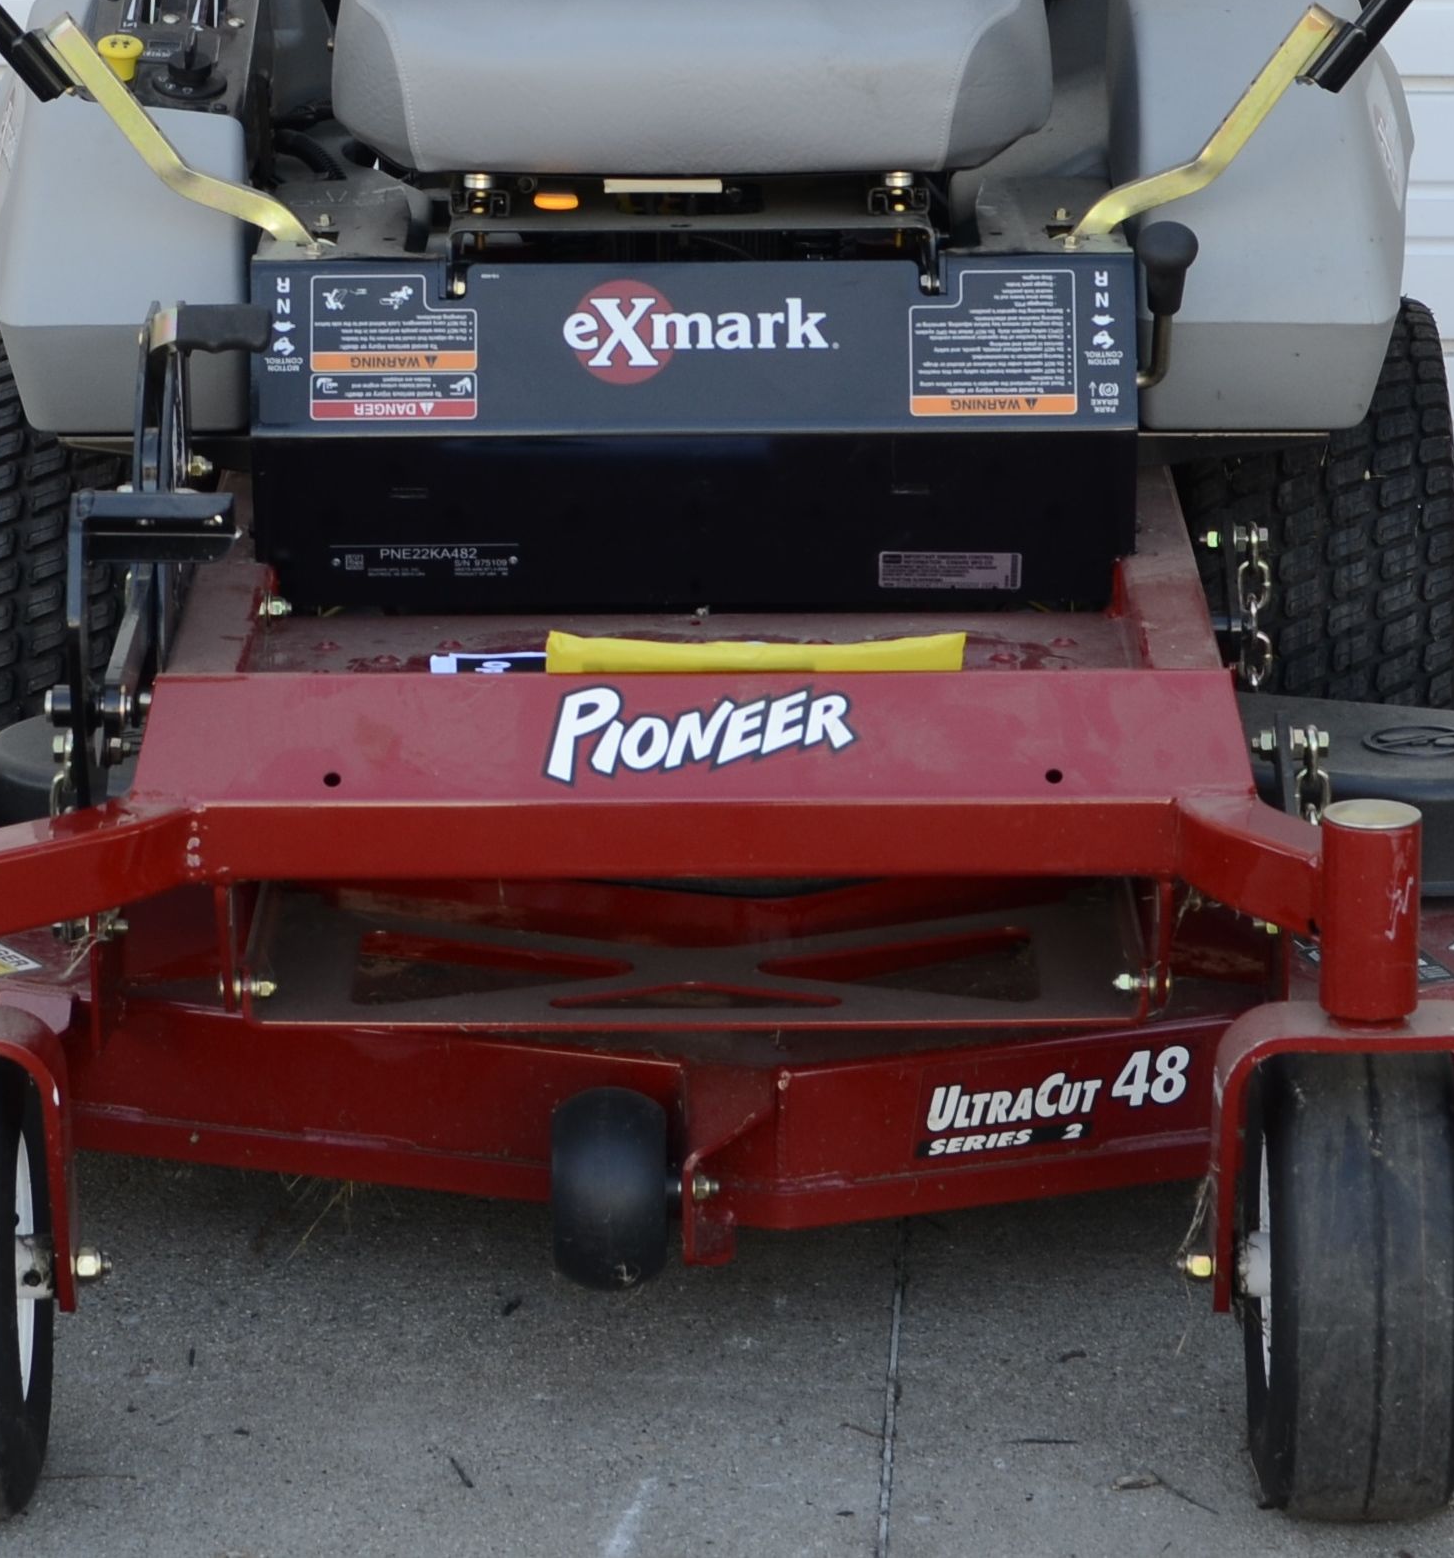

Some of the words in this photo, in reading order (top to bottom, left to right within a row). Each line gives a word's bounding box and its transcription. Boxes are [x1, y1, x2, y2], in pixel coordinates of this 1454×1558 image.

[277, 278, 290, 293] R
[1095, 271, 1108, 286] R
[277, 299, 290, 314] N
[1095, 292, 1109, 307] N
[563, 297, 829, 367] eXmark
[350, 357, 420, 368] WARNING
[354, 403, 417, 416] DANGER
[950, 398, 1021, 410] WARNING
[380, 547, 478, 560] PNE22KA482
[454, 559, 470, 567] S/N
[547, 687, 853, 782] PIONEER
[1111, 1045, 1190, 1107] 48
[928, 1129, 1033, 1156] SERIES
[1061, 1123, 1083, 1139] 2
